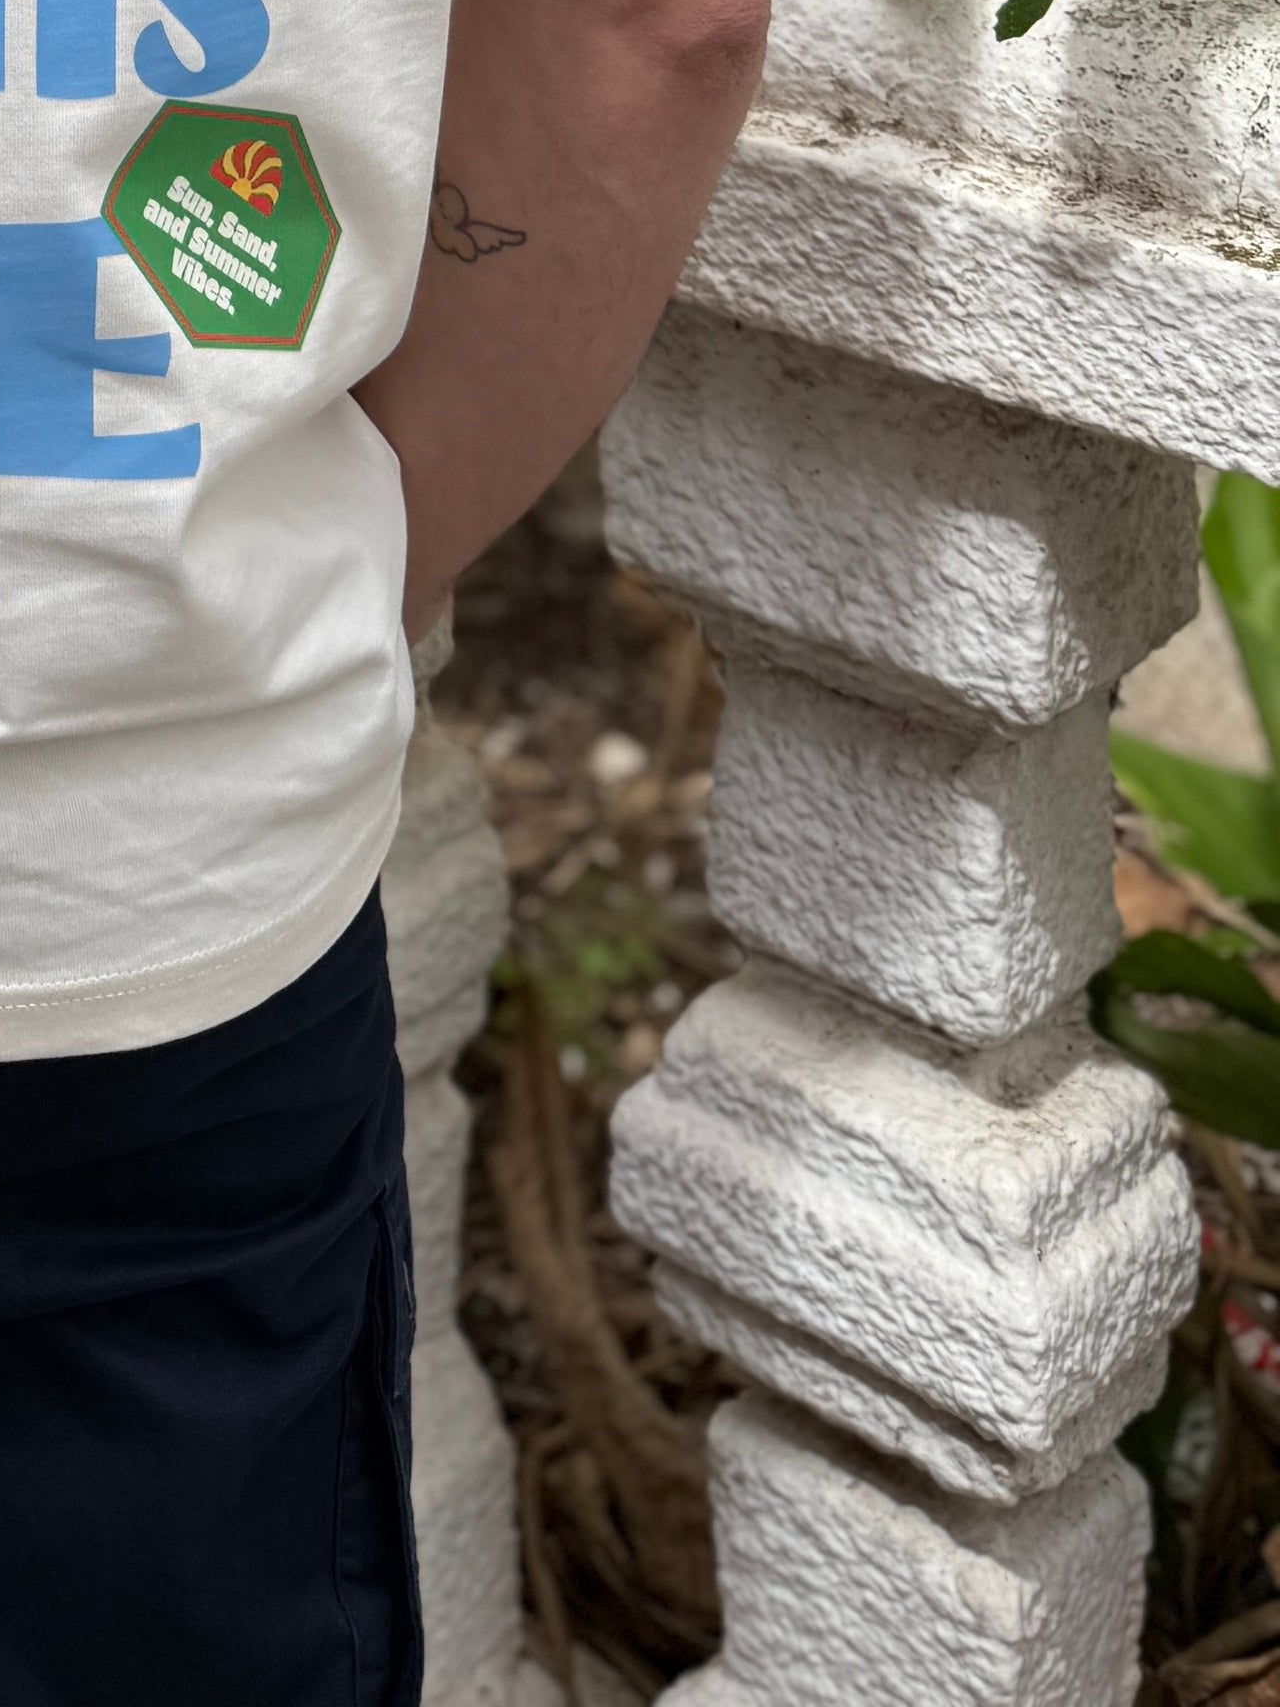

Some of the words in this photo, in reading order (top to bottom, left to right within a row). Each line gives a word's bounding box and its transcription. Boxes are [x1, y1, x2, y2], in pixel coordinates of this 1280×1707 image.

[143, 198, 191, 245] and
[188, 226, 283, 308] Summer
[166, 175, 215, 229] Sun,
[218, 211, 278, 273] Sand,
[171, 247, 236, 316] Vibes.
